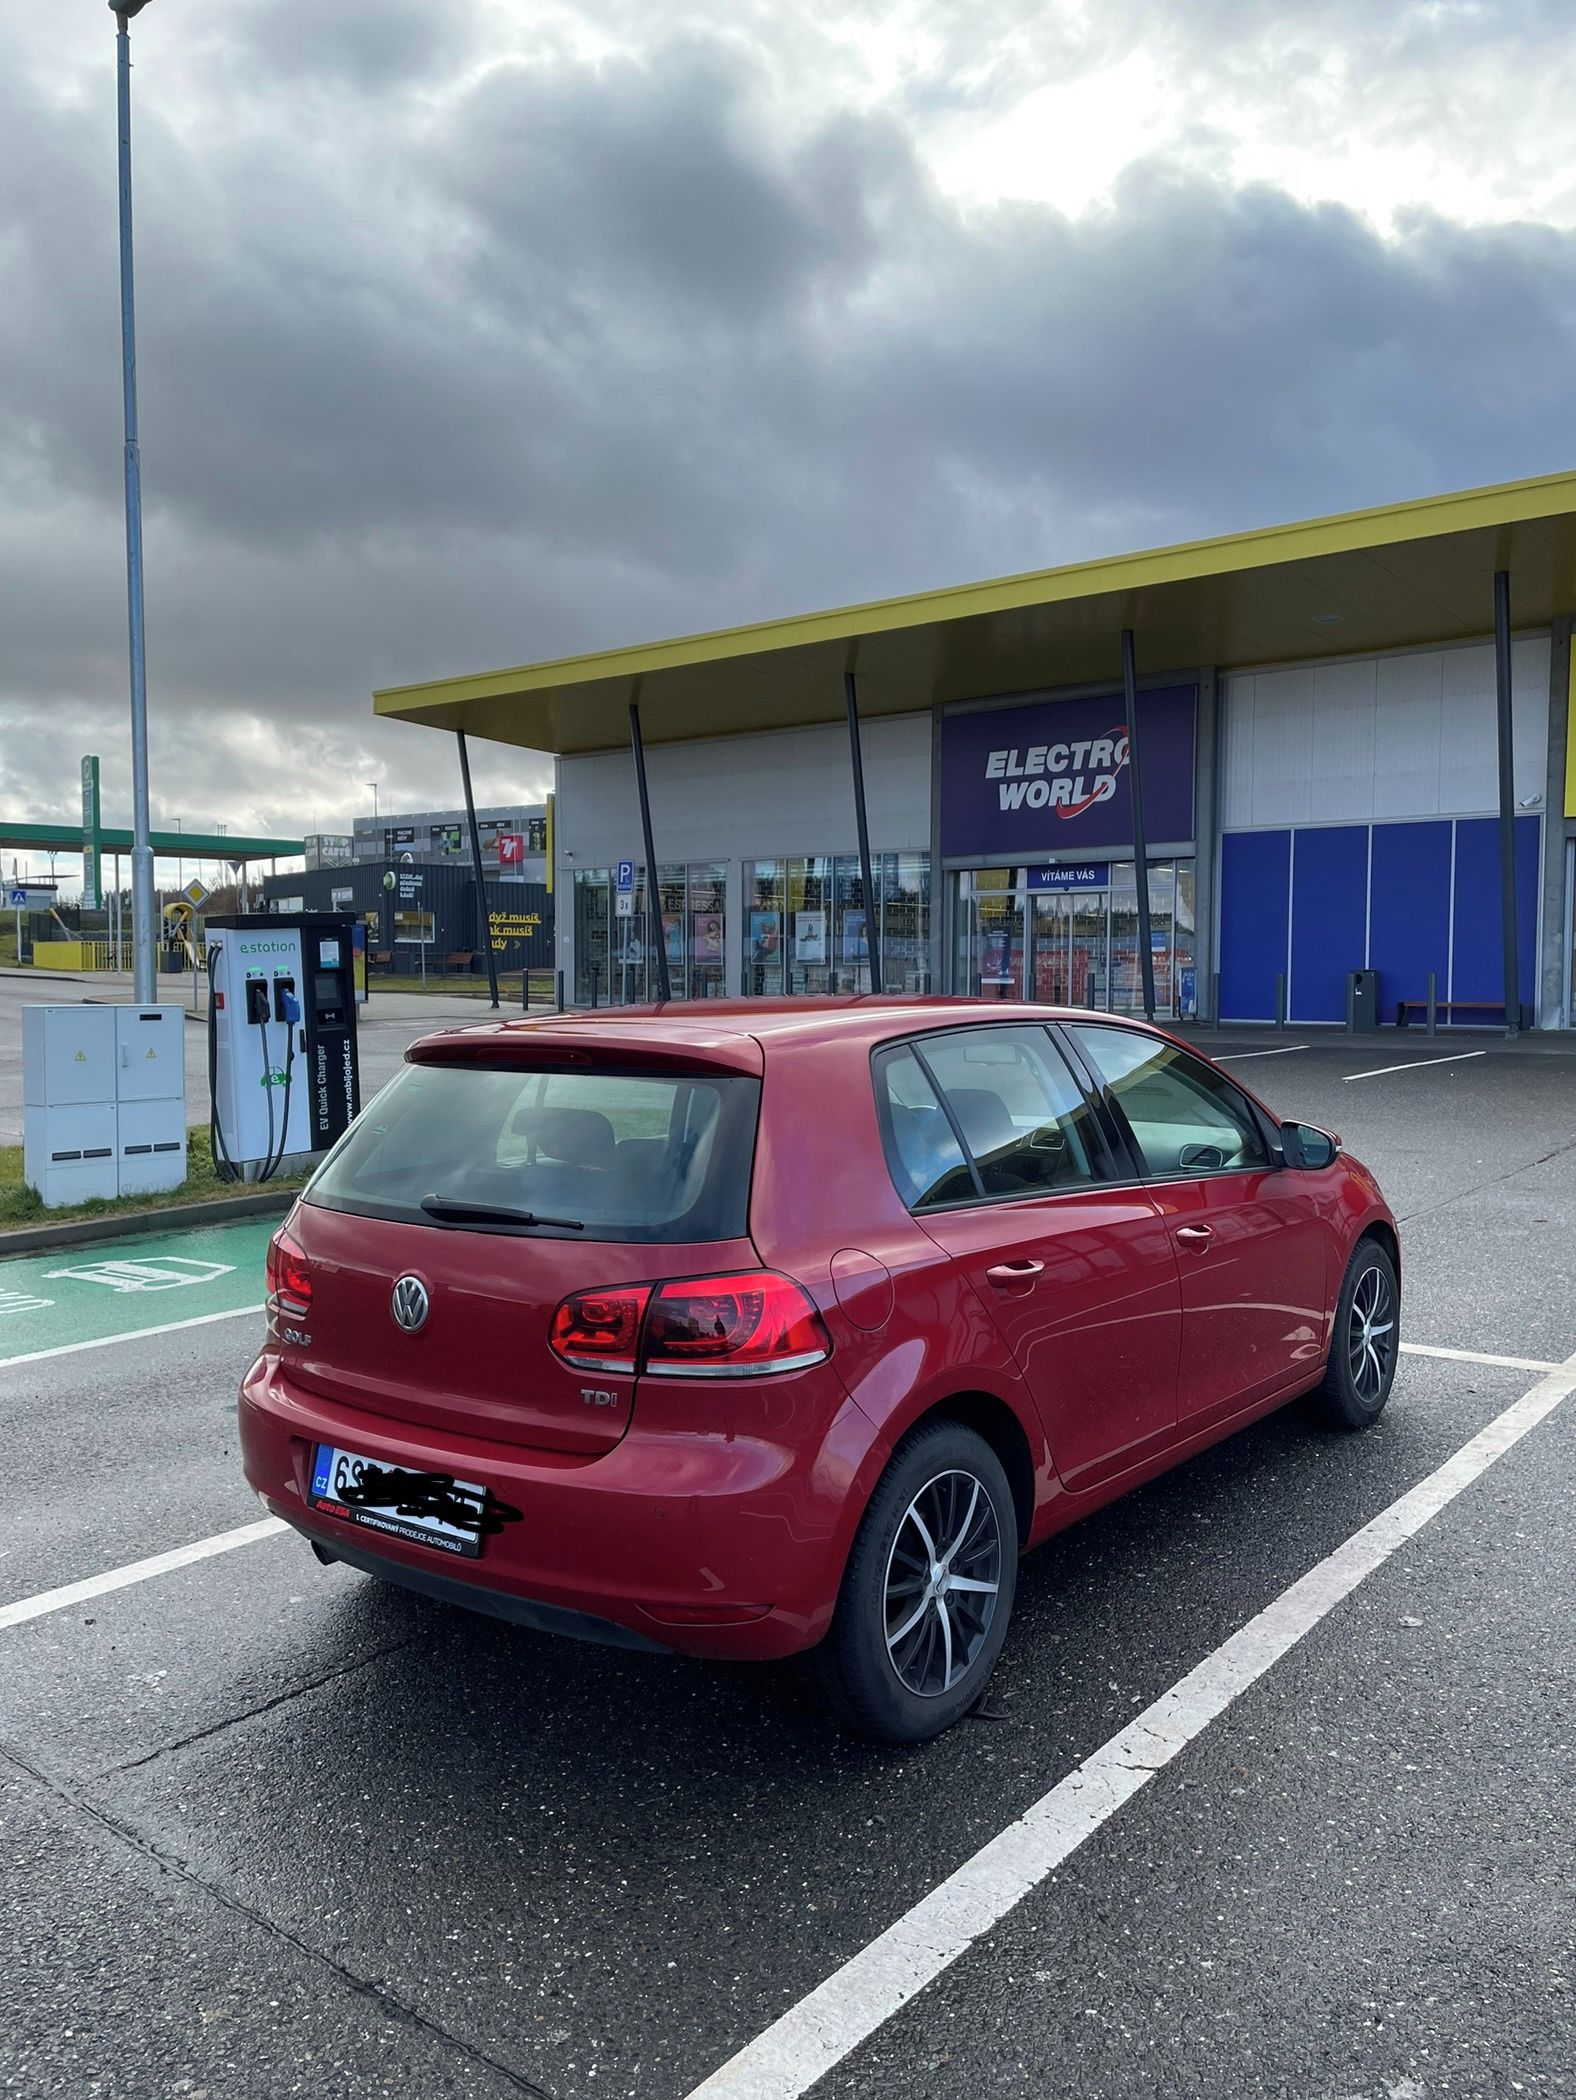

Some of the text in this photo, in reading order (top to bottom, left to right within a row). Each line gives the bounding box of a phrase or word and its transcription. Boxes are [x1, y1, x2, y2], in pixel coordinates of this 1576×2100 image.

[985, 736, 1131, 779] ELECTRO
[998, 774, 1117, 811] WORLD
[620, 864, 631, 883] P
[1041, 868, 1096, 881] VÍTÁME VÁS
[488, 911, 507, 924] dyž
[317, 1044, 329, 1131] EV Quick Charger
[284, 1327, 312, 1346] GOLF
[580, 1388, 618, 1407] TDI
[315, 1476, 328, 1490] CZ
